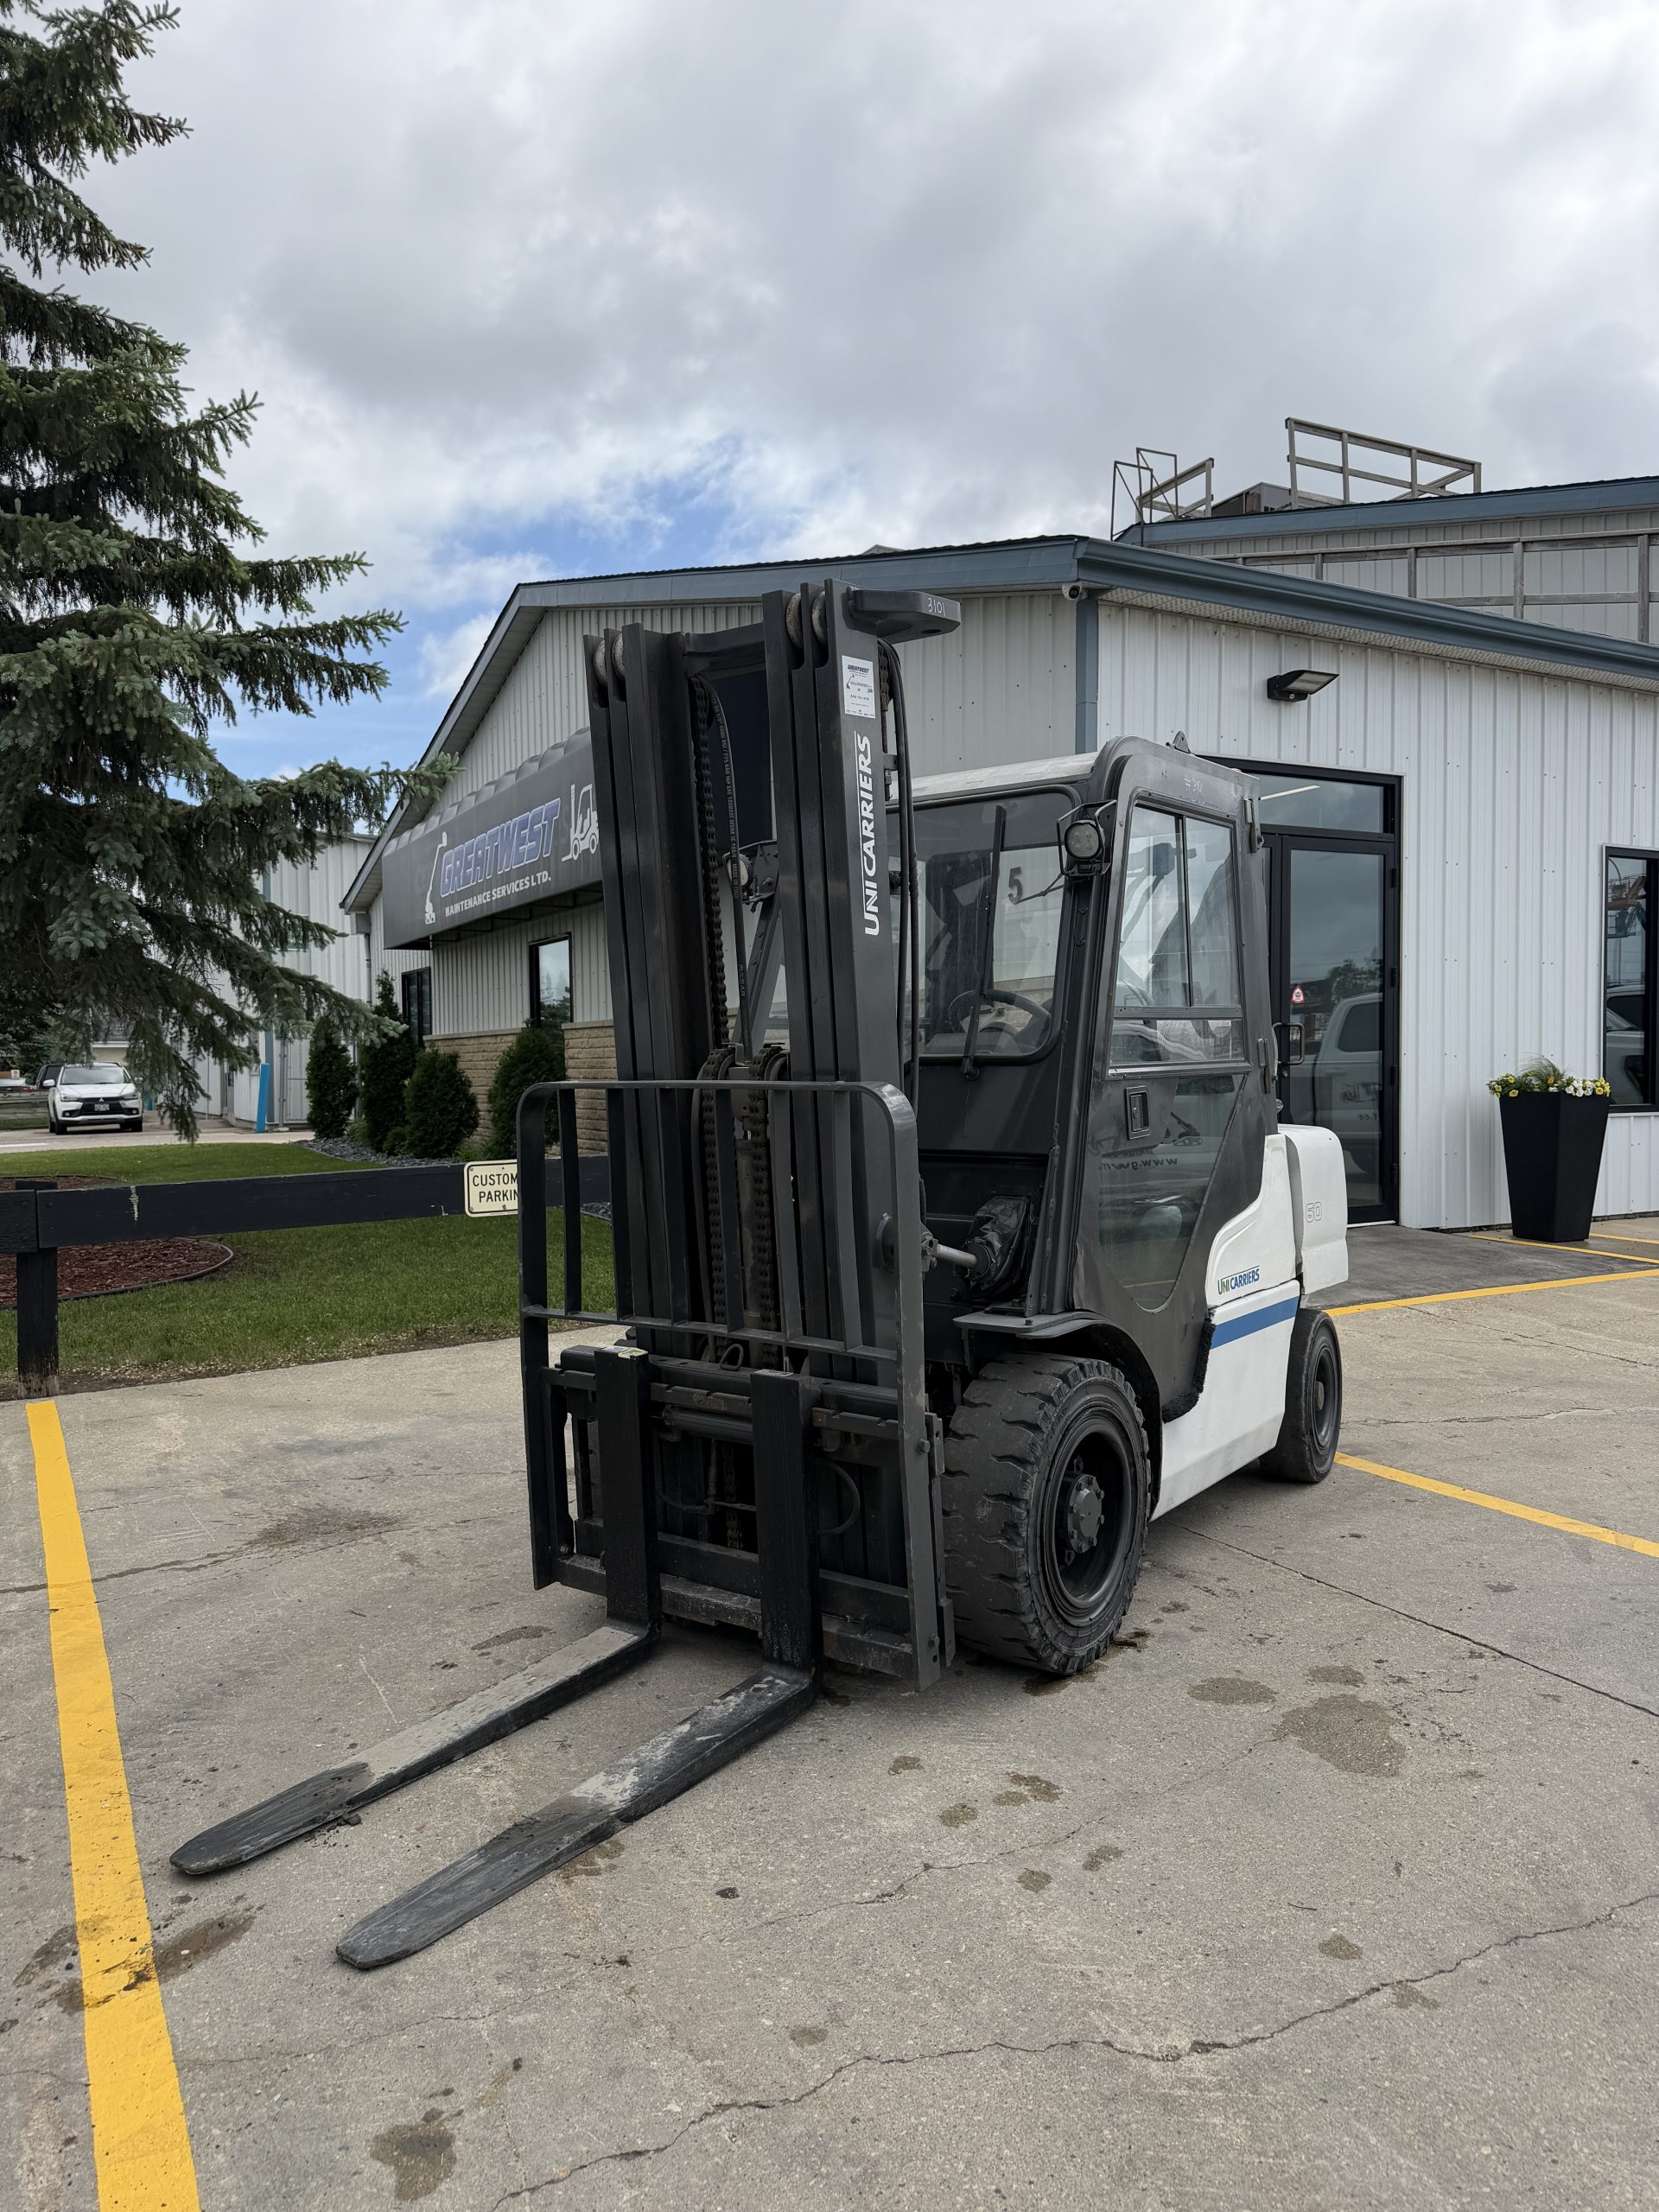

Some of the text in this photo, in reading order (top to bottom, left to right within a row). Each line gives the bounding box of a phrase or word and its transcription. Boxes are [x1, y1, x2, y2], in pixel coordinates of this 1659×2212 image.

[927, 597, 946, 617] 3101
[440, 798, 561, 898] GREATWEST
[445, 870, 551, 917] MAINTENANCE SERVICES LTD.
[474, 1173, 518, 1186] CUSTOM
[480, 1189, 518, 1203] PARKIN
[1305, 1201, 1323, 1224] 60
[1217, 1267, 1260, 1295] UNICARRIERS
